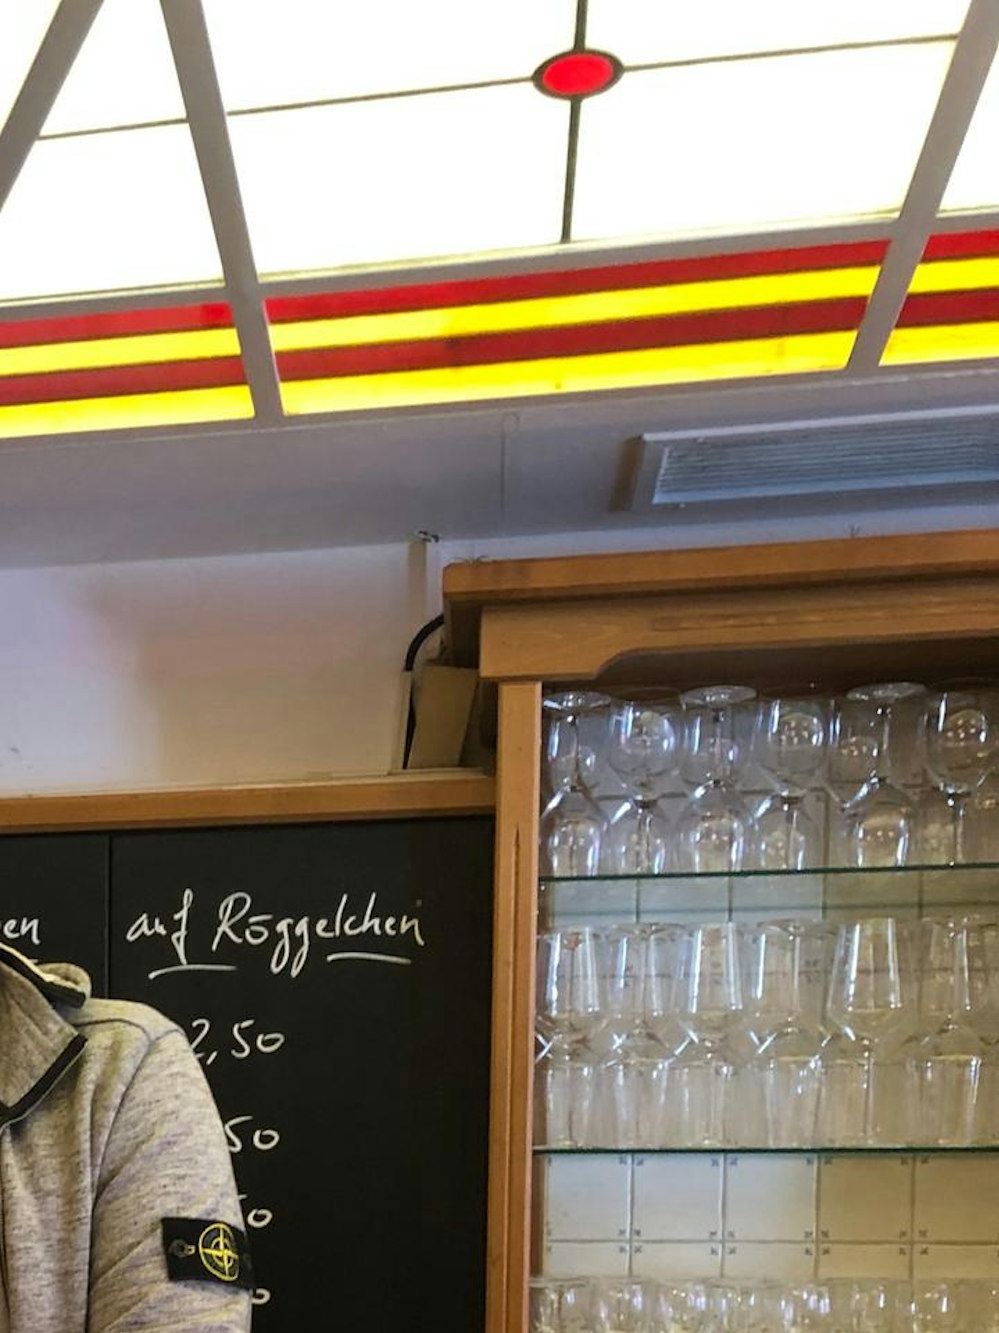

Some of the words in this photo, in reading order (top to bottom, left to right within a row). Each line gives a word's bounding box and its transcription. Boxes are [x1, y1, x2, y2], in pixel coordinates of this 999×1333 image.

[126, 888, 194, 965] auf
[190, 1018, 286, 1066] 2,50
[224, 1115, 280, 1154] 50
